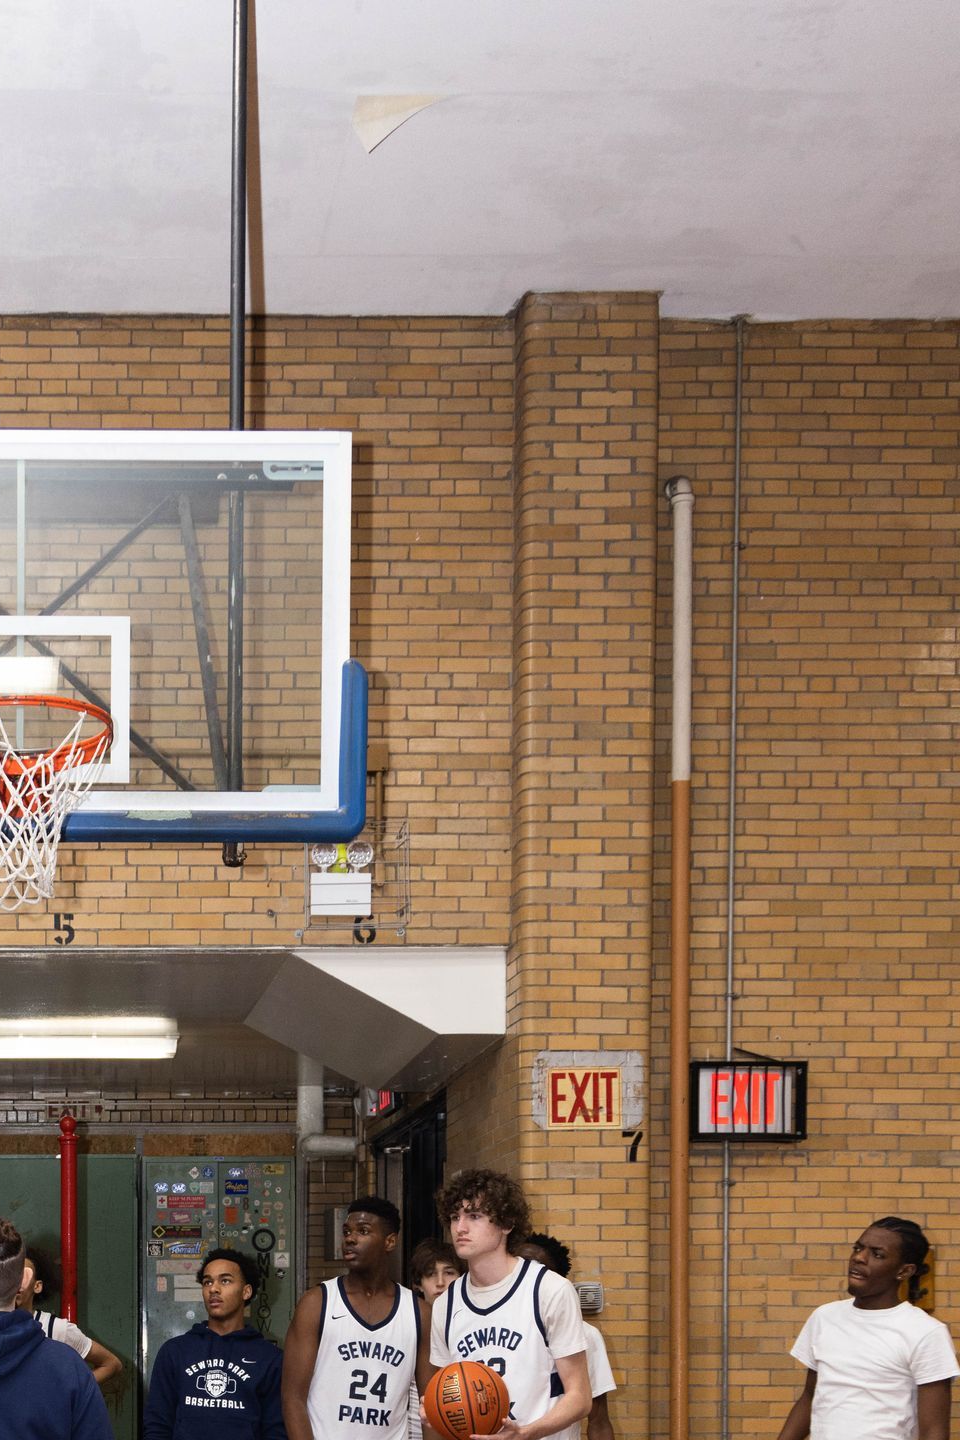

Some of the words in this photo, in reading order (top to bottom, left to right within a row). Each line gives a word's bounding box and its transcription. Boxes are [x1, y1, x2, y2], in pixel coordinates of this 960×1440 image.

[54, 913, 75, 945] 5
[354, 914, 376, 944] 6
[551, 1071, 618, 1124] EXIT
[710, 1072, 781, 1126] EXIT
[622, 1131, 643, 1162] 7
[337, 1340, 405, 1368] SEWARD
[457, 1326, 523, 1358] SEWARD
[185, 1358, 225, 1377] SEWARD
[227, 1362, 251, 1382] PARK
[349, 1369, 388, 1403] 24
[442, 1372, 462, 1405] ROCK
[185, 1395, 245, 1410] BASKETBALL
[338, 1404, 392, 1427] PARK
[445, 1408, 468, 1432] THE
